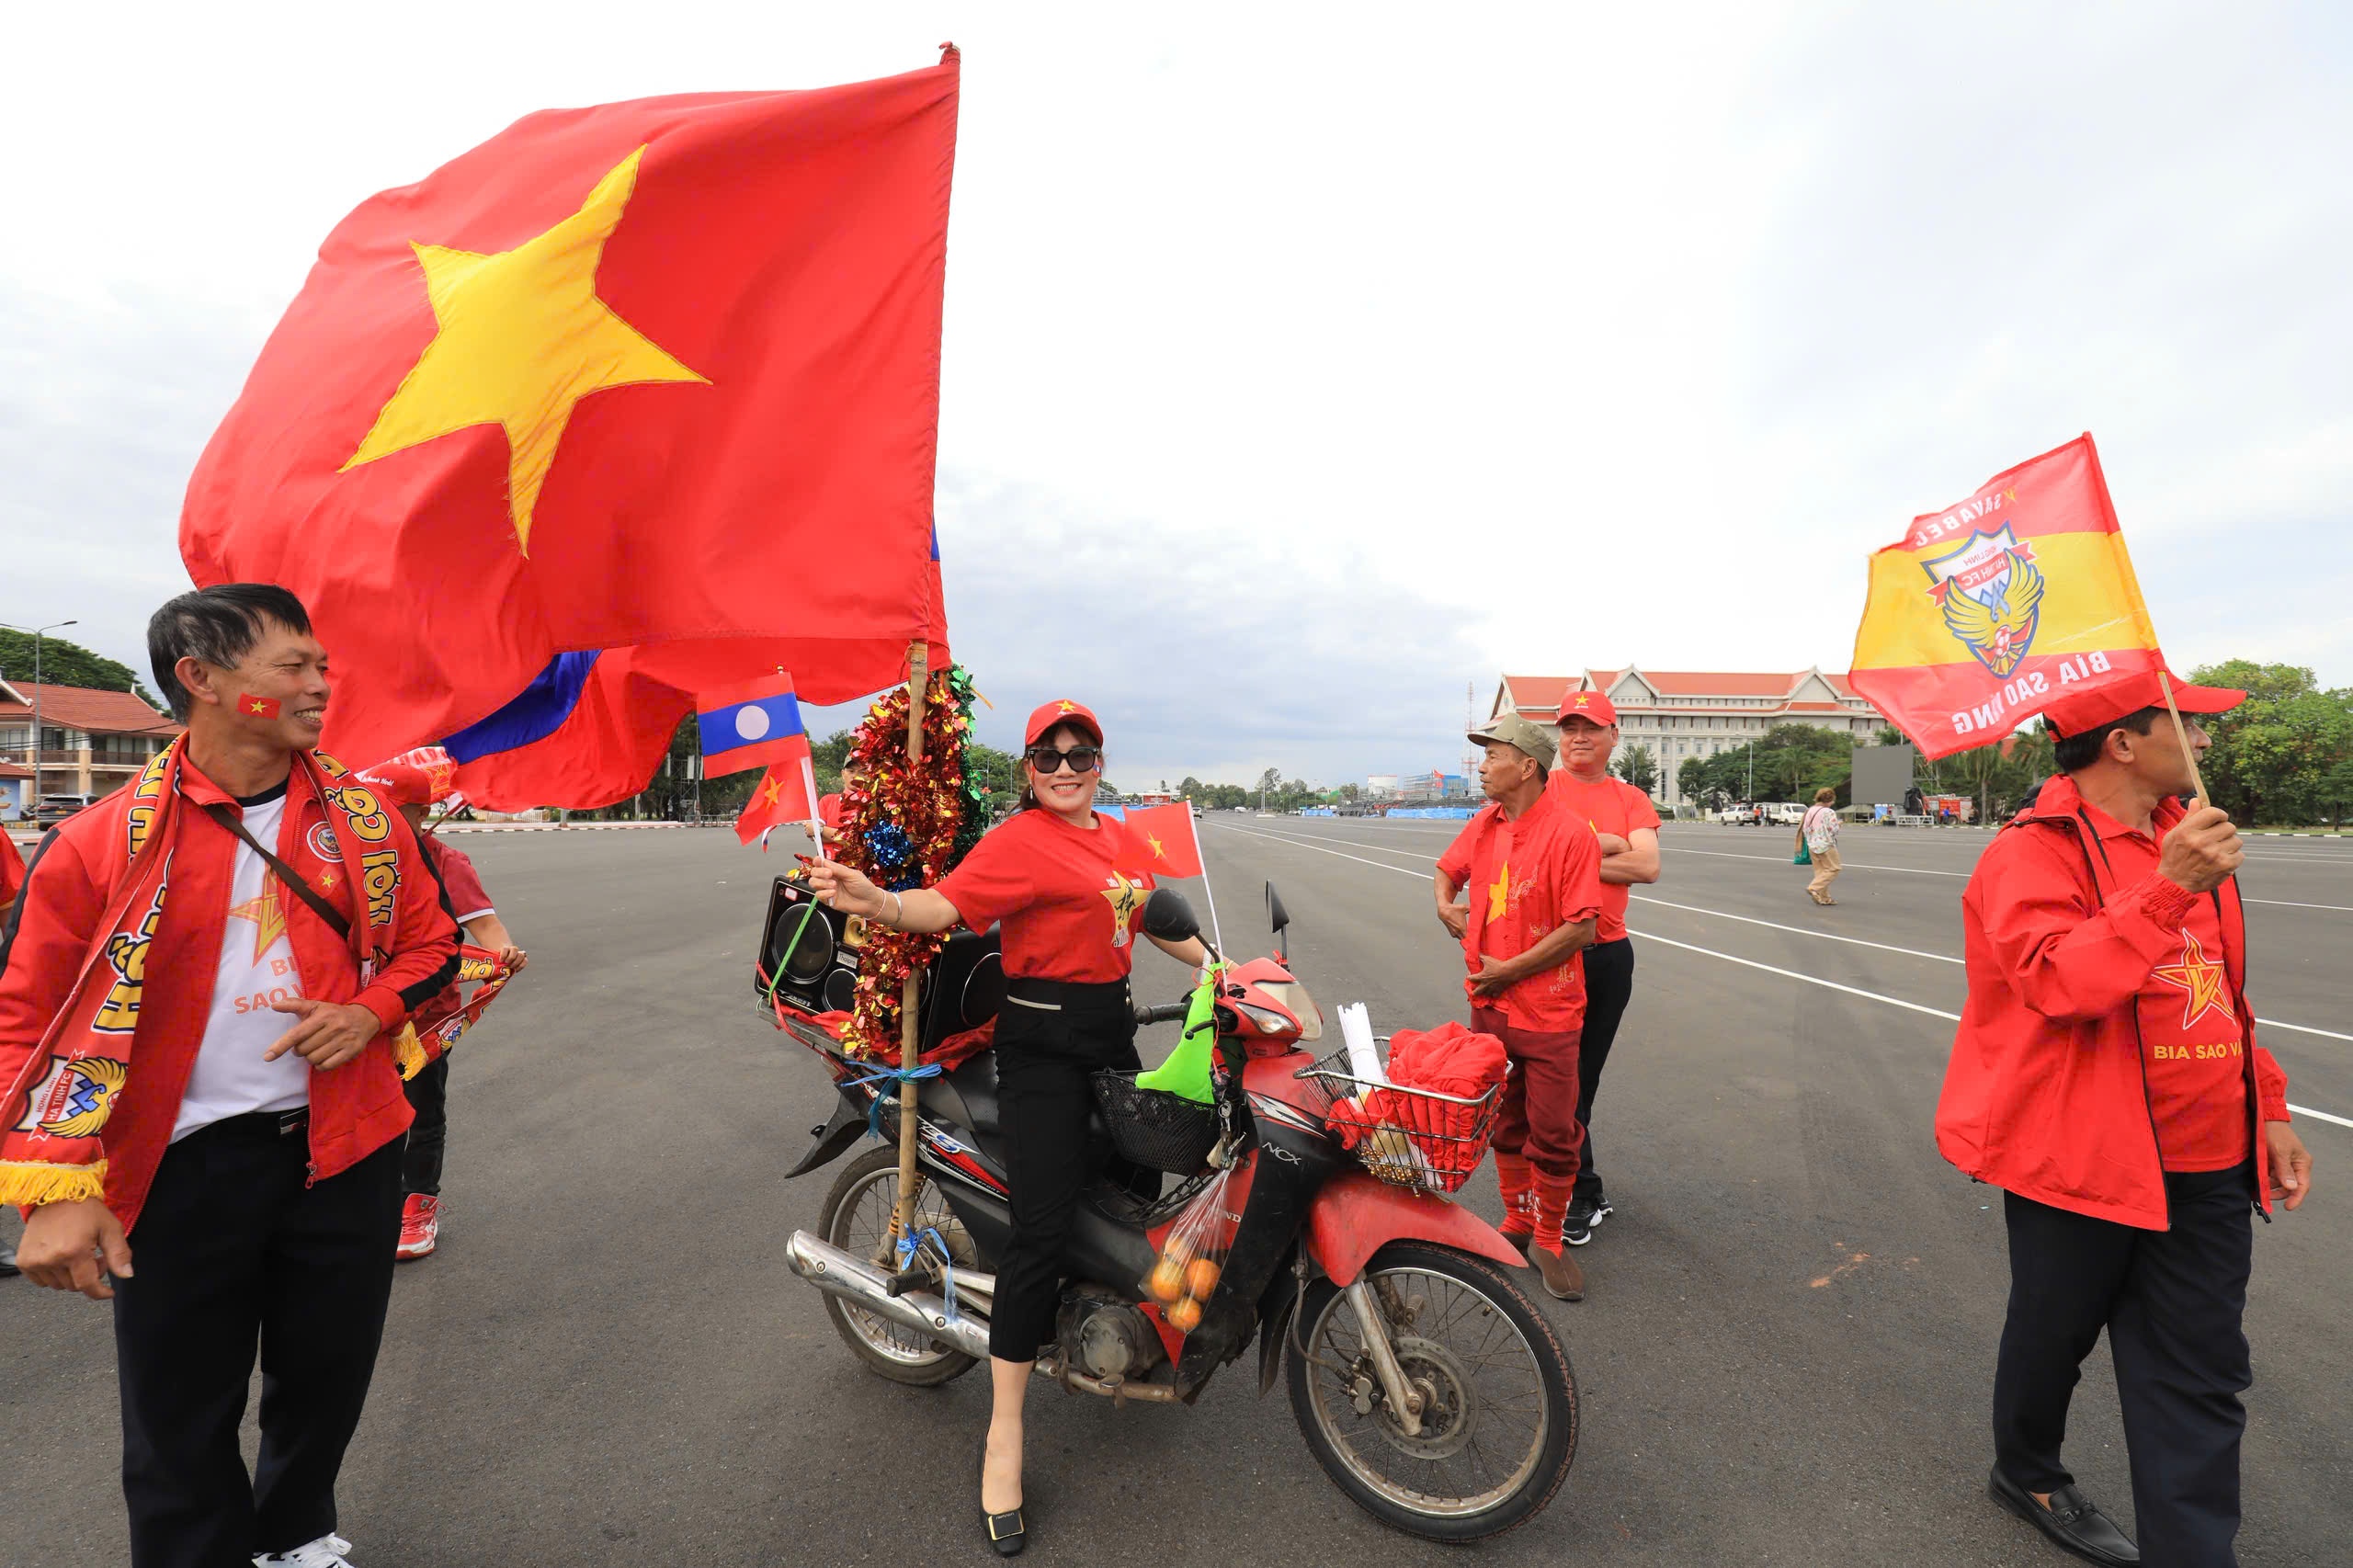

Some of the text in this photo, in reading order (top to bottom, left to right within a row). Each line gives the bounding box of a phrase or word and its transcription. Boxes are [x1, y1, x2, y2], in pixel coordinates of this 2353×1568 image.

[270, 956, 297, 976] BI
[233, 987, 288, 1015] SAO
[2154, 1045, 2191, 1060] BIA
[2195, 1043, 2227, 1060] SAO
[61, 1073, 72, 1087] FC
